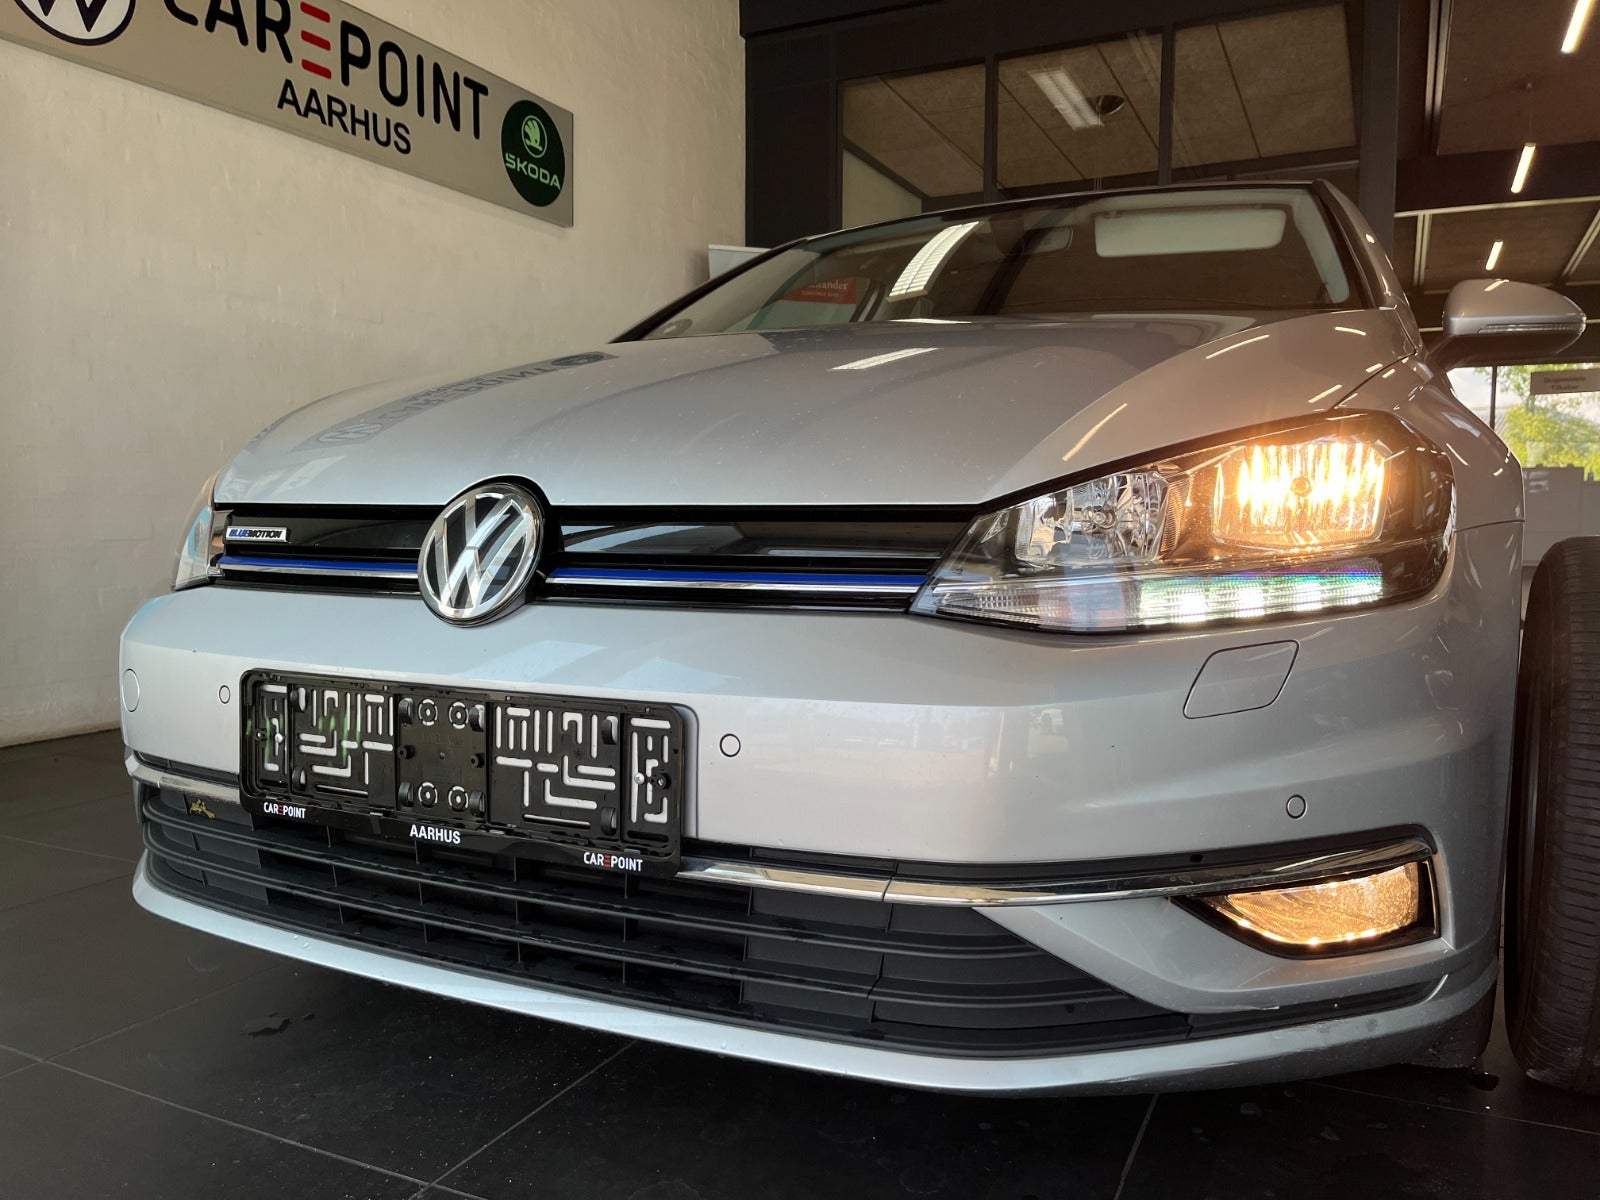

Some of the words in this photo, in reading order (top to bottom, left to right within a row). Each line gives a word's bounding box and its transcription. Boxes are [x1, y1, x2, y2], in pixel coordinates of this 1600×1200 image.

[277, 79, 412, 154] AARHUS
[228, 523, 284, 539] BLUEMOTION
[409, 824, 461, 845] AARHUS
